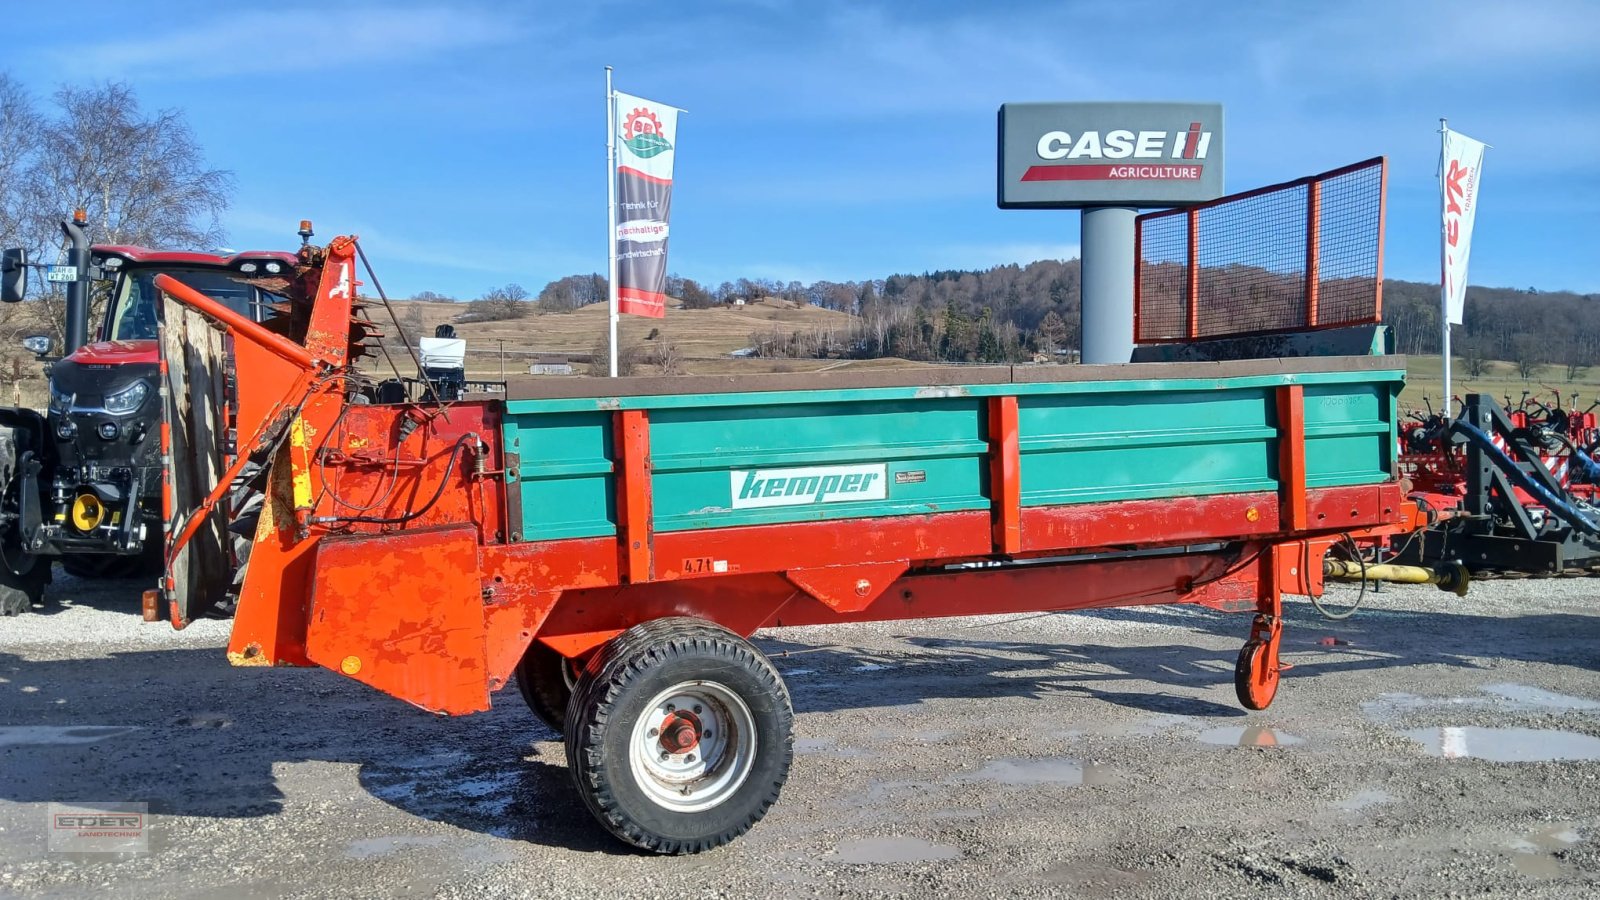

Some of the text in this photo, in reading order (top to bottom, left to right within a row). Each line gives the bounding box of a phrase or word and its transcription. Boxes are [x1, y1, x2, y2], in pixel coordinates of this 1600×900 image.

[1036, 129, 1167, 160] CASE
[1108, 166, 1198, 179] AGRICULTURE
[1464, 166, 1475, 213] TRAKTOREN
[620, 200, 659, 211] Technik für
[618, 225, 664, 237] nachhaltige
[738, 469, 879, 503] kemper
